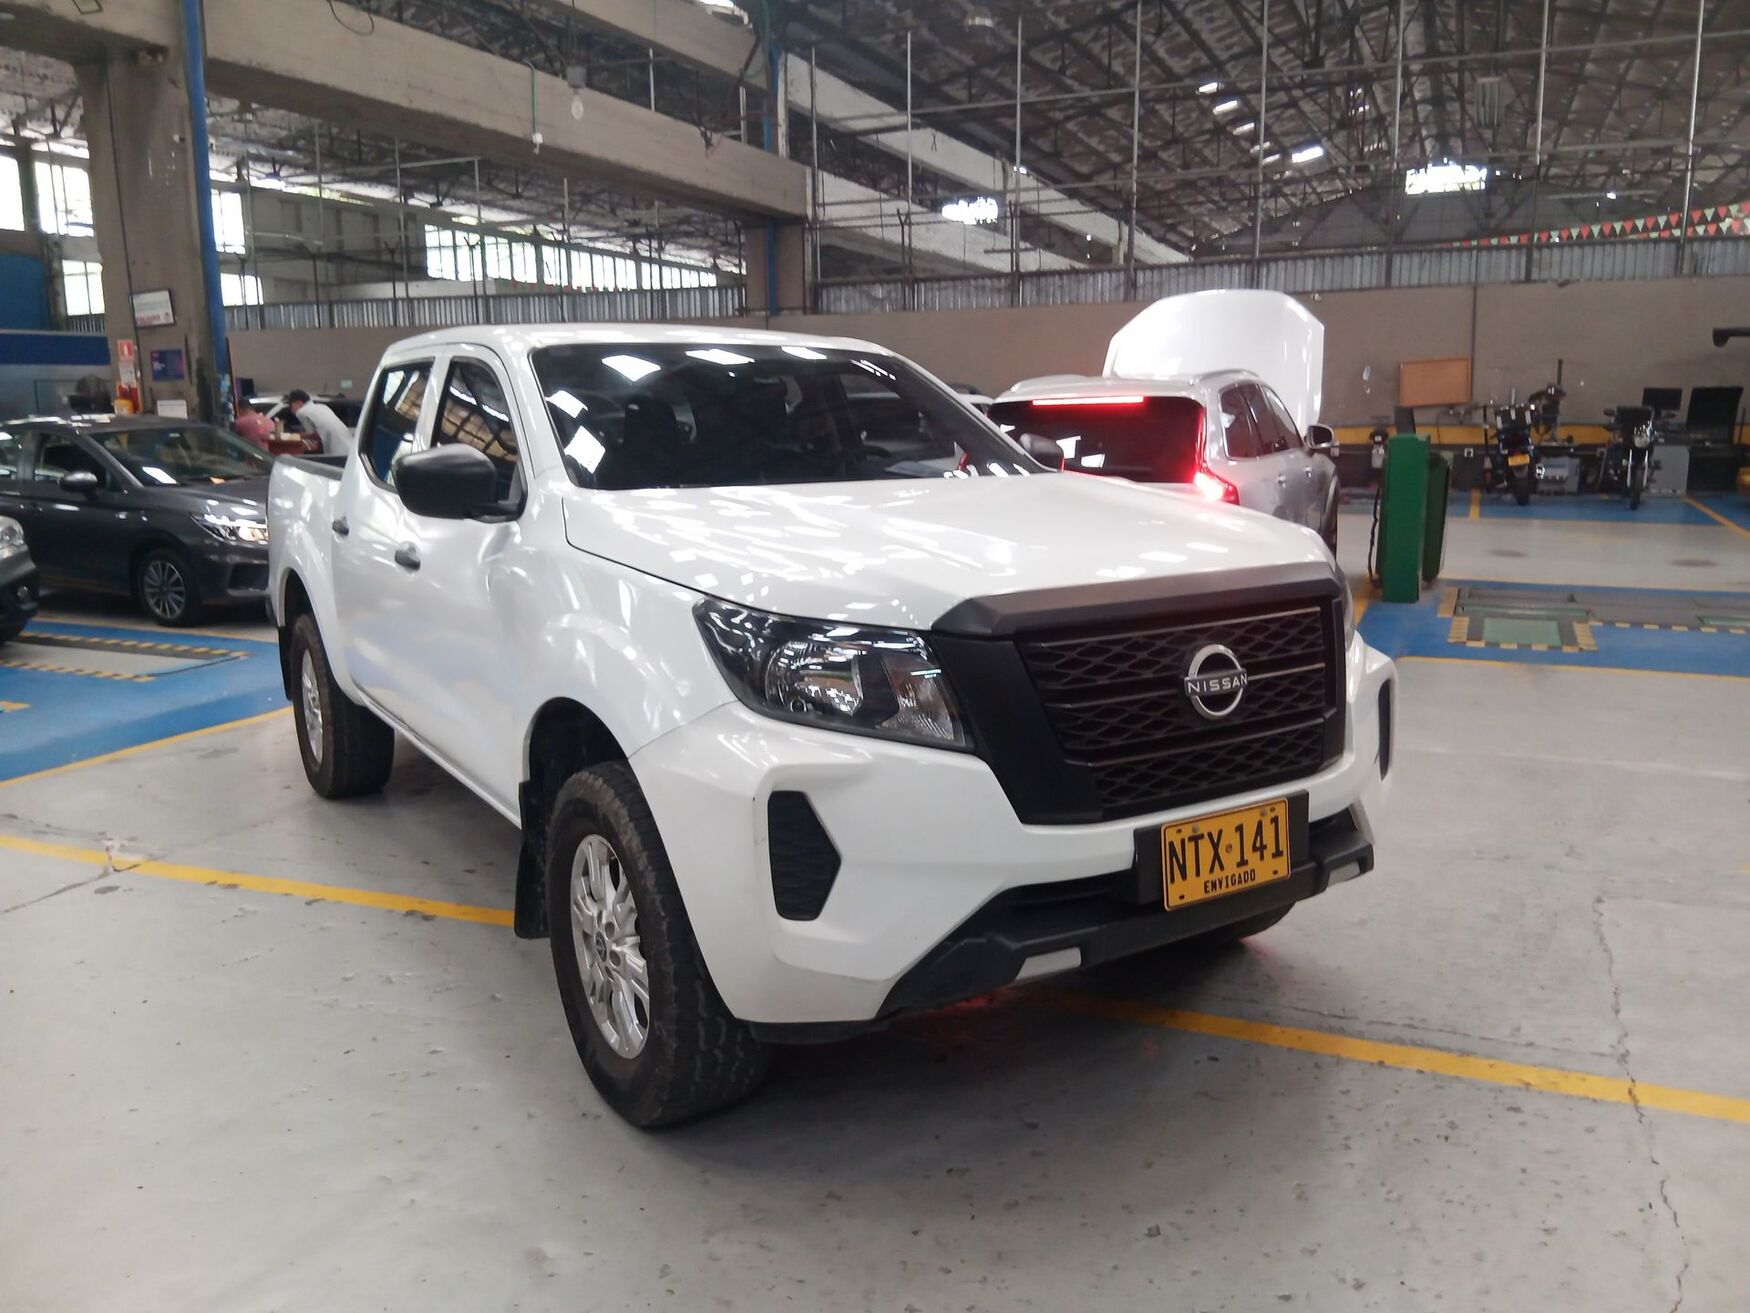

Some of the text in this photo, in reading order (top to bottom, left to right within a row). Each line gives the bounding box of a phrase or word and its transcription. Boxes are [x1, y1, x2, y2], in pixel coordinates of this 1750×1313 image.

[1187, 673, 1247, 693] NISSAN
[1168, 815, 1284, 884] NTX 141
[1204, 868, 1256, 894] ENVIGADO
